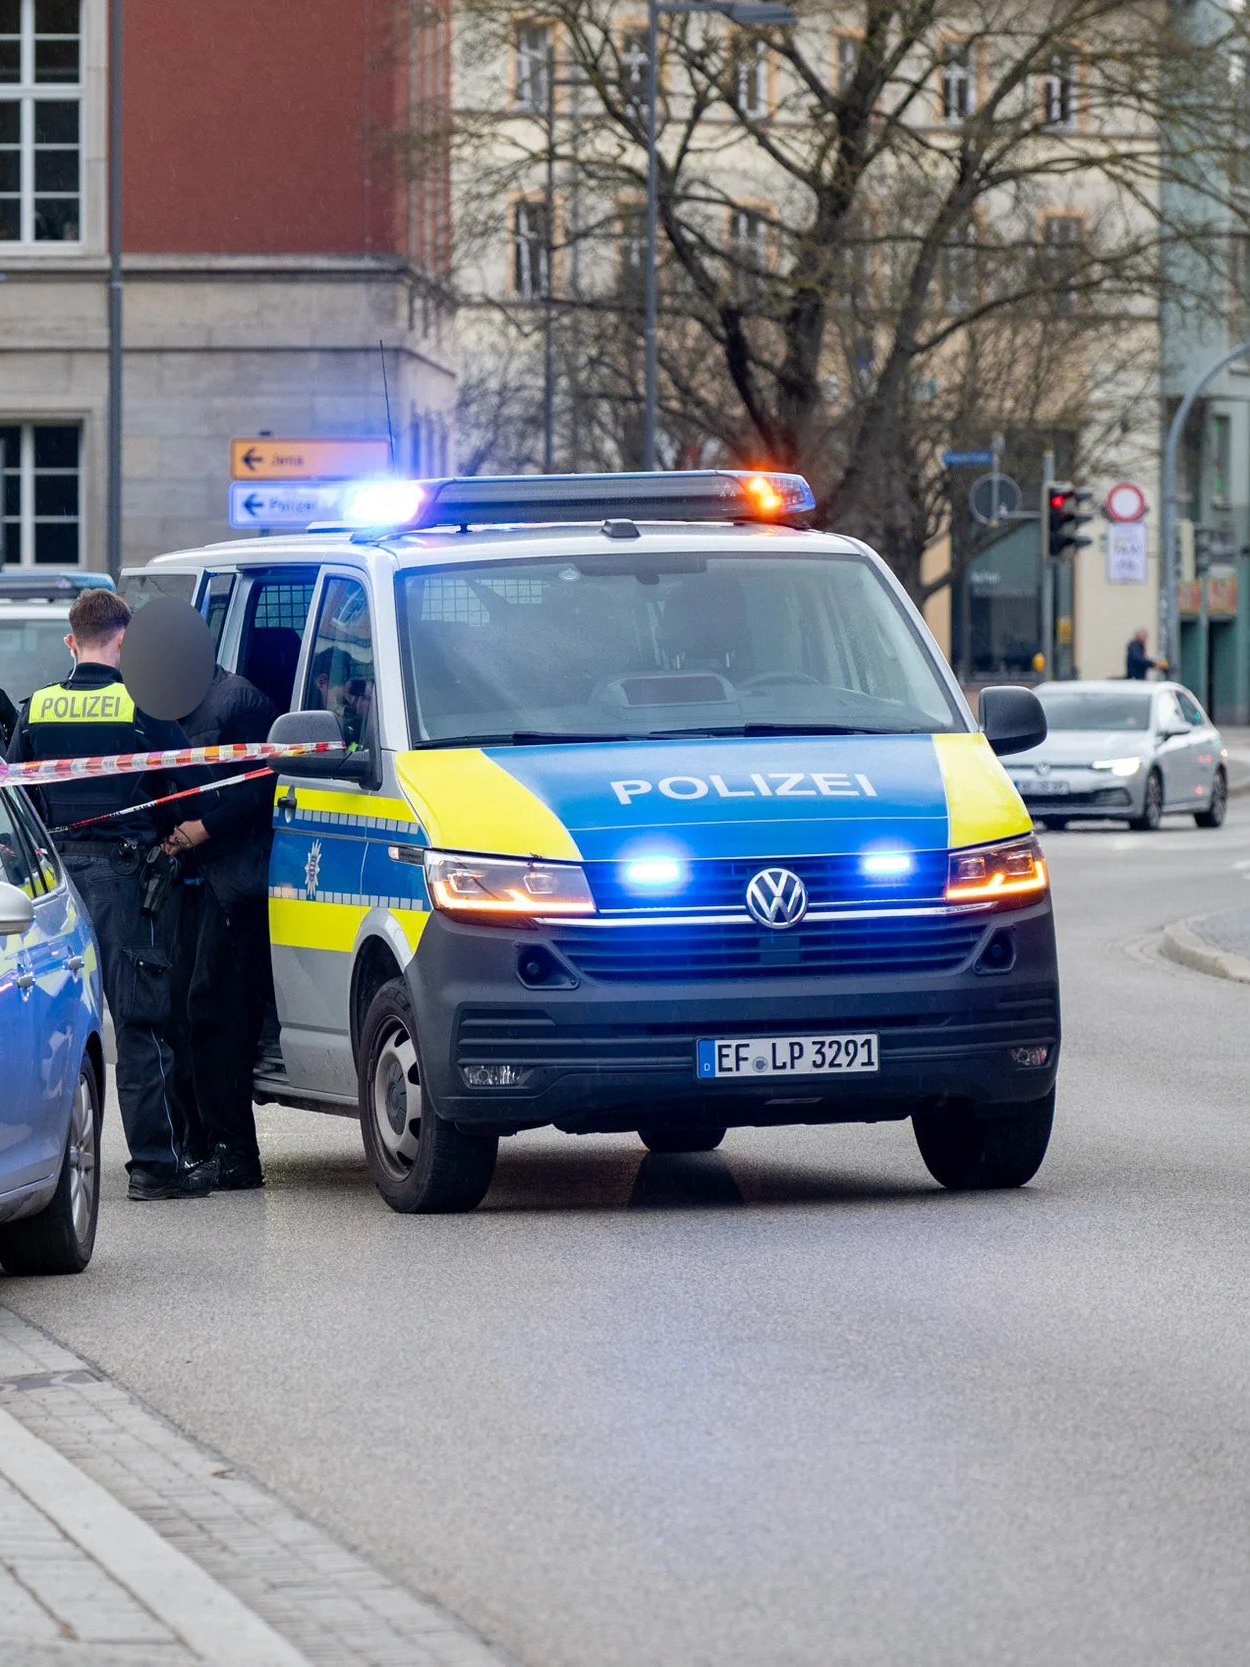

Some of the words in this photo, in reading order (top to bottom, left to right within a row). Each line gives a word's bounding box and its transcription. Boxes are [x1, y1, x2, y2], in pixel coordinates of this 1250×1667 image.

[270, 454, 304, 466] Jena
[41, 696, 120, 718] POLIZEI
[610, 773, 878, 805] POLIZEI
[718, 1043, 750, 1072] EF
[772, 1042, 804, 1070] LP
[812, 1038, 875, 1069] 3291
